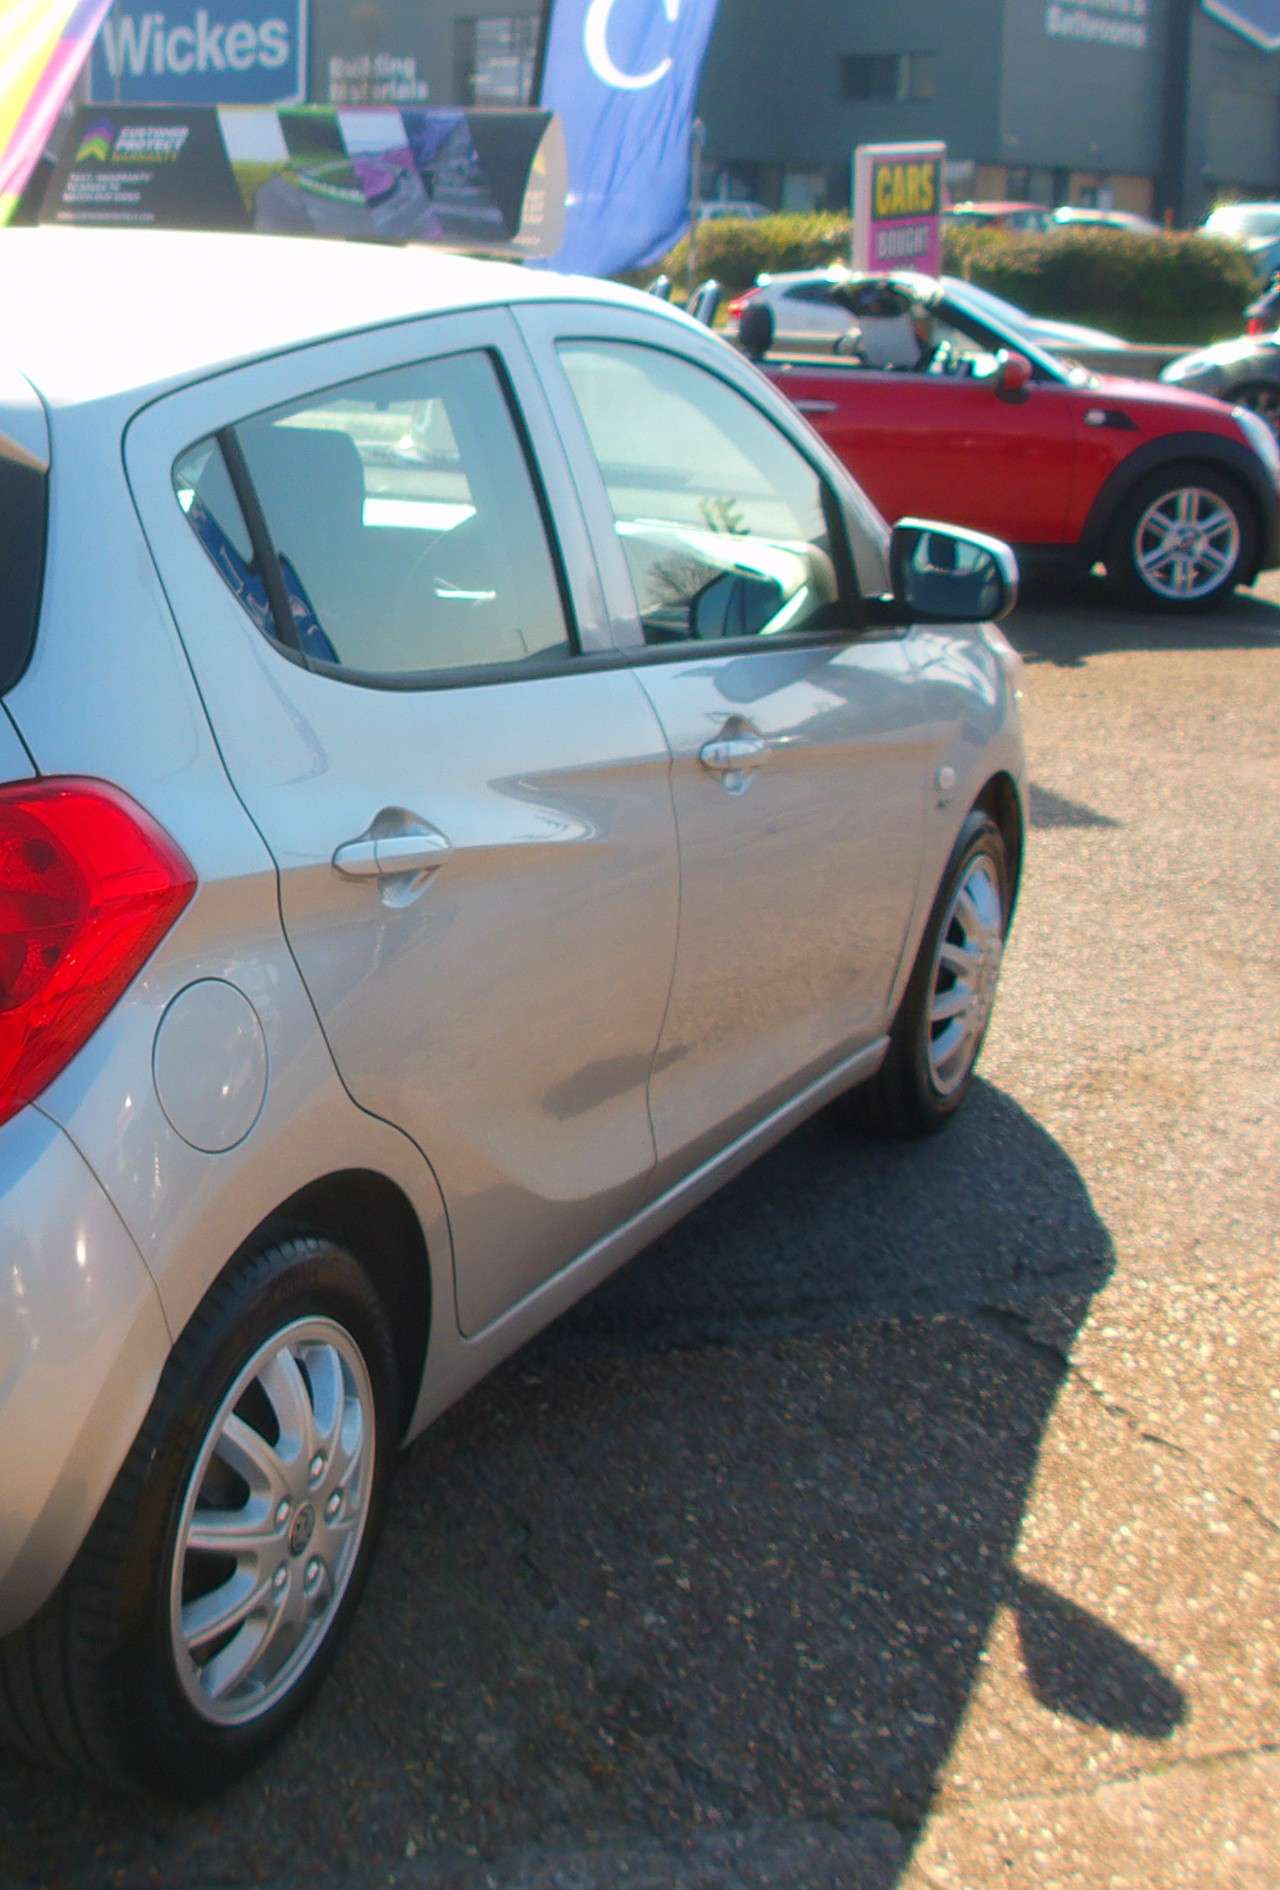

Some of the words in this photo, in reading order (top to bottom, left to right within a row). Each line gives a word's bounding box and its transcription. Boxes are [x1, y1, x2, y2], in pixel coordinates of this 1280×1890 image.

[104, 9, 289, 77] Wickes
[583, 0, 678, 90] C
[876, 163, 935, 215] CARS
[876, 224, 929, 259] BOUGHT
